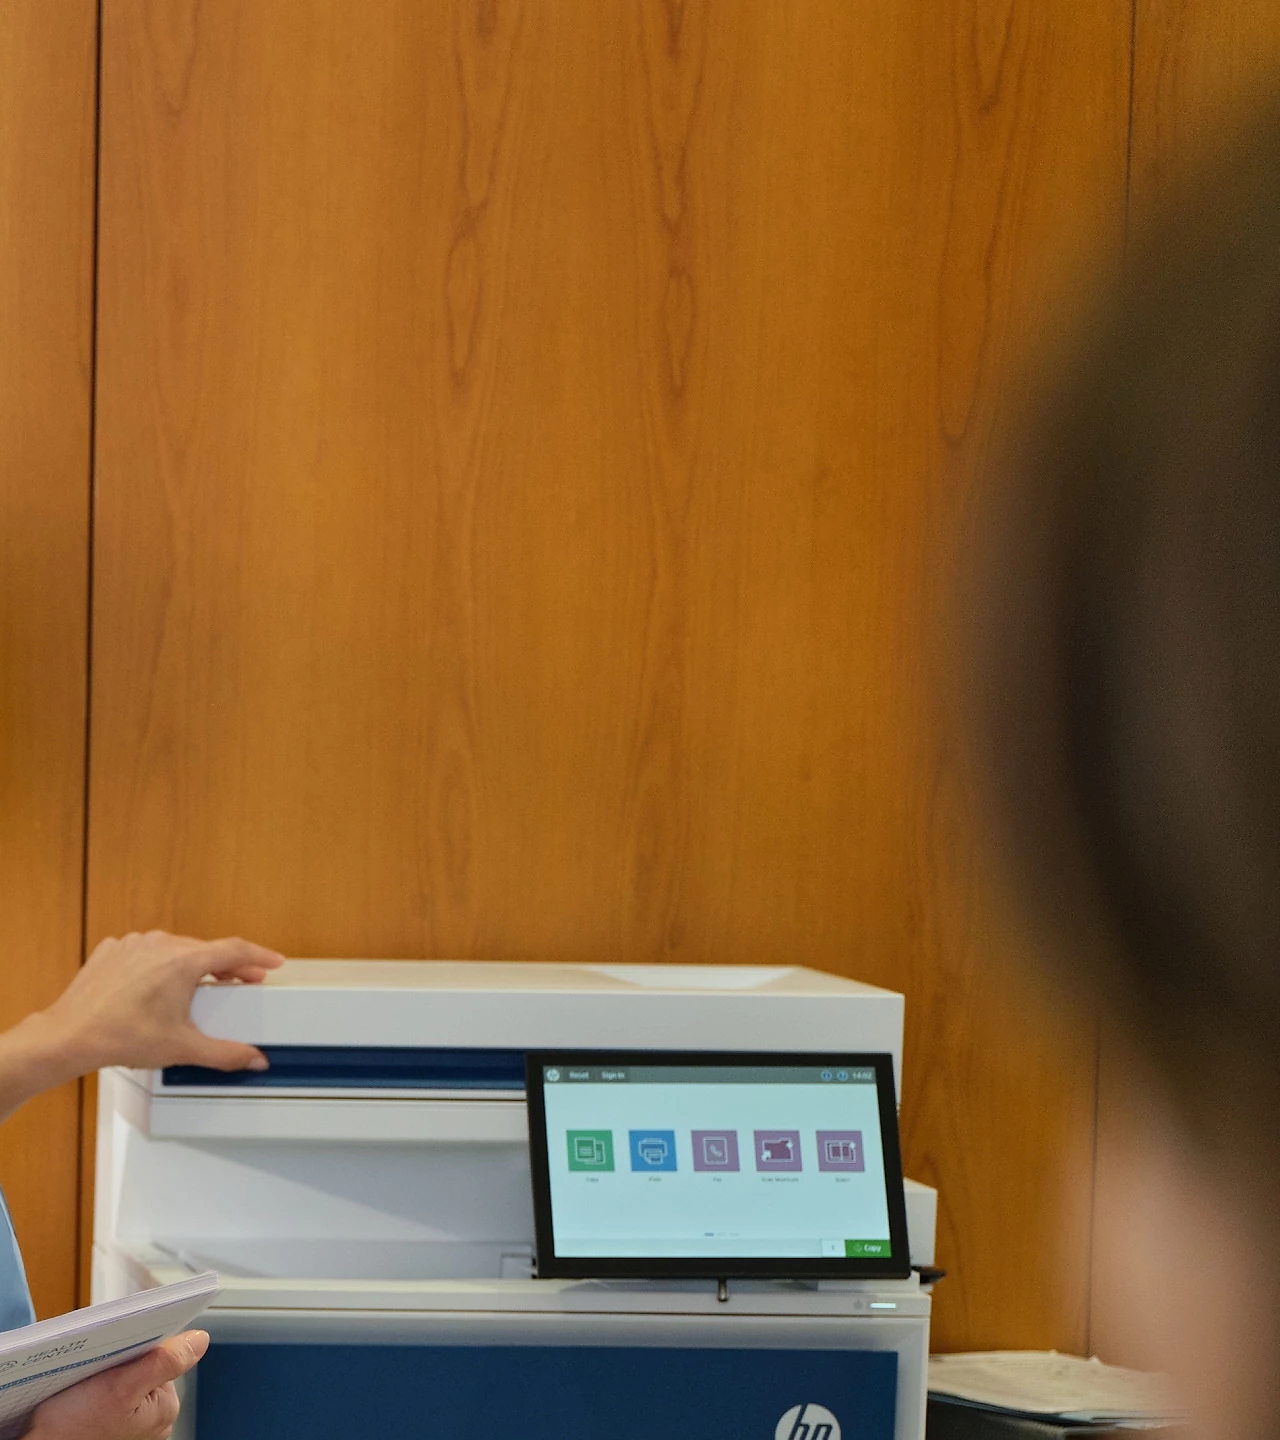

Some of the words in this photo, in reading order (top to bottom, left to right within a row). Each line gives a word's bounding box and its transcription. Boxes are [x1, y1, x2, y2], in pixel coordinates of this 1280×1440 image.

[864, 1243, 881, 1253] Copy
[21, 1344, 85, 1366] CENTER
[25, 1338, 89, 1361] HEALTH
